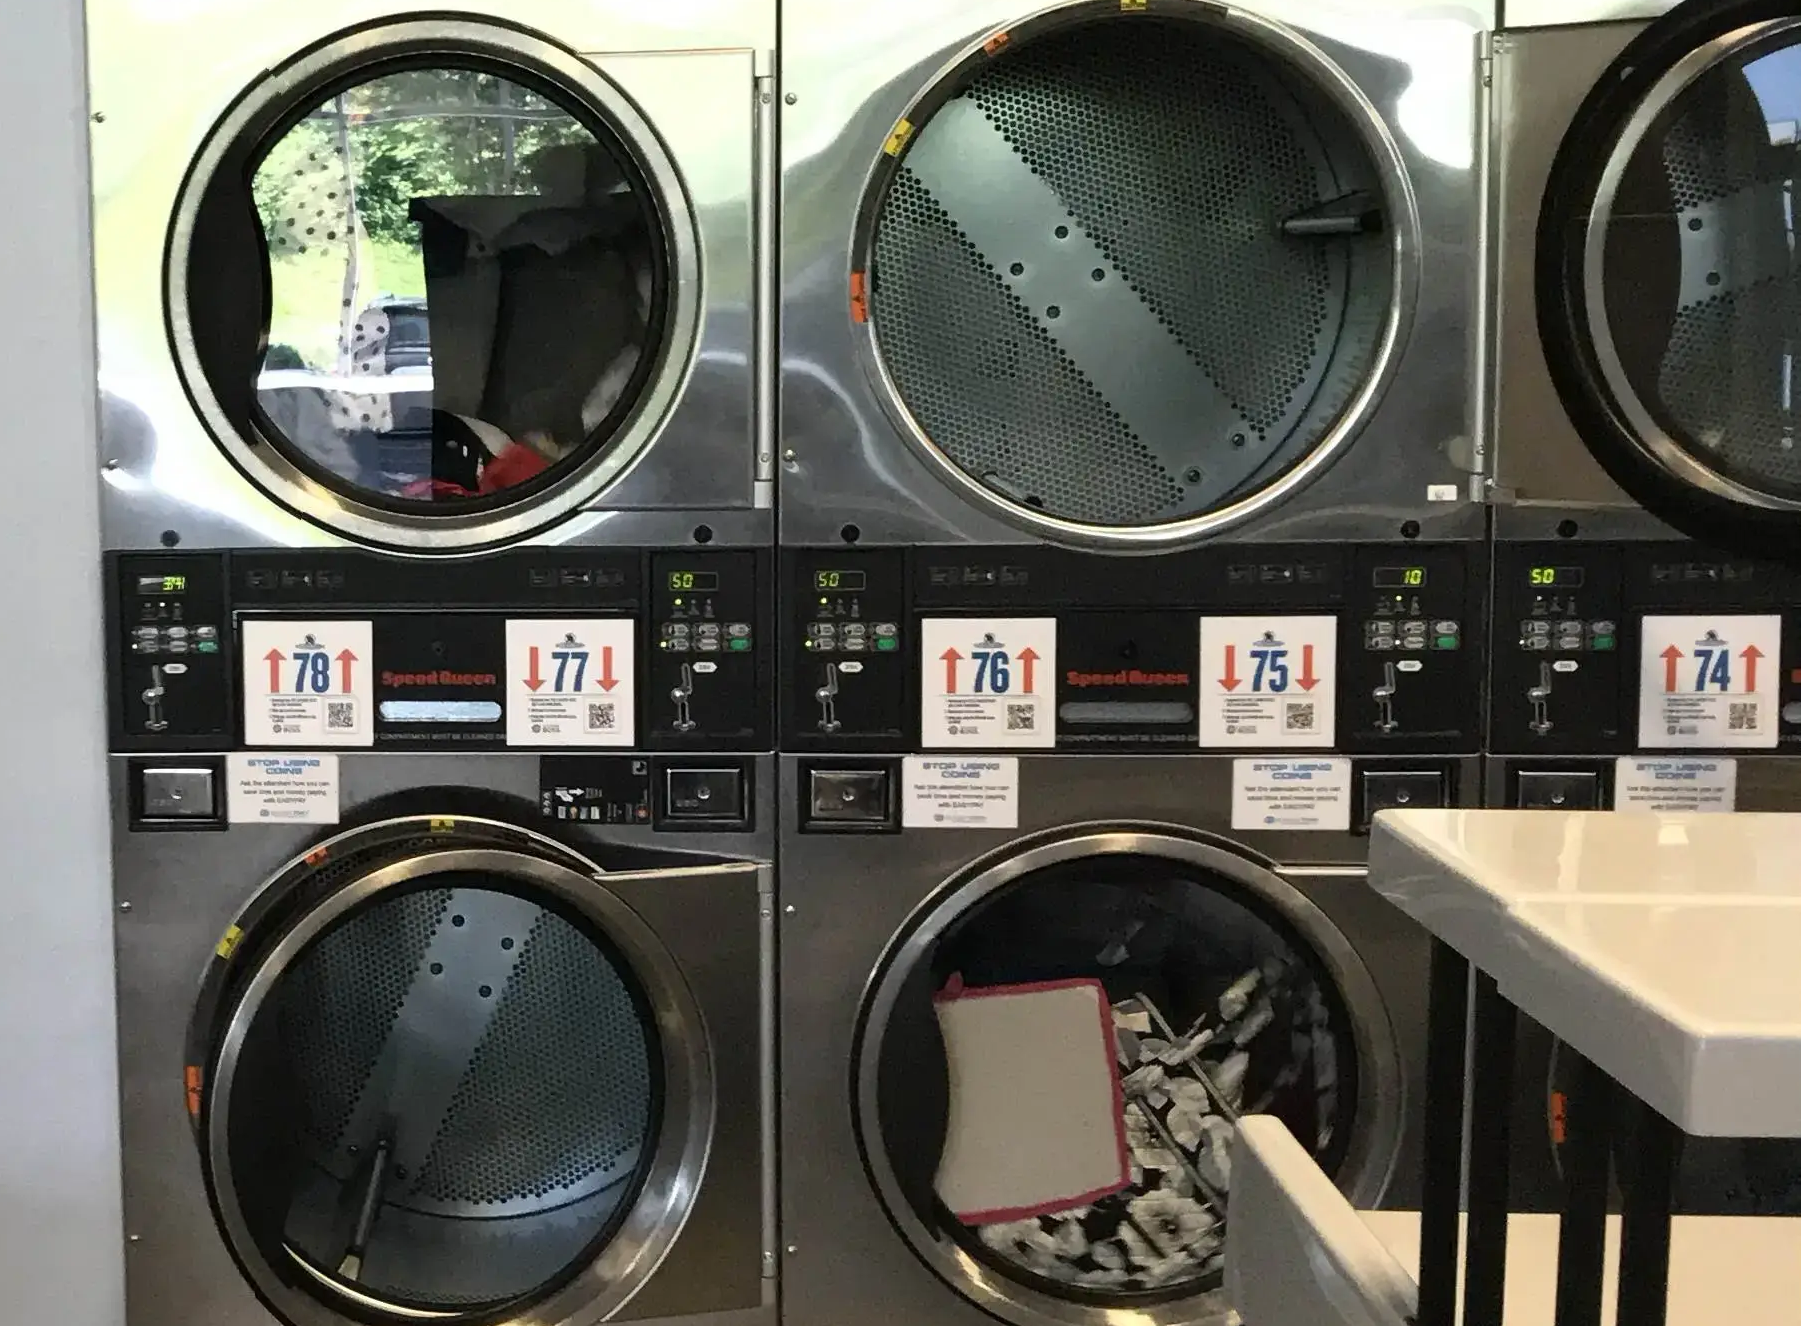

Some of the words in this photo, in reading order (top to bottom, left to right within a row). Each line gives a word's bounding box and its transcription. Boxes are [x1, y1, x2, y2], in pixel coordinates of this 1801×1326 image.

[292, 652, 330, 693] 78
[551, 651, 590, 692] 77
[971, 651, 1010, 693] 76
[1249, 650, 1289, 692] 75
[1693, 649, 1731, 692] 74
[247, 759, 280, 767] STOP
